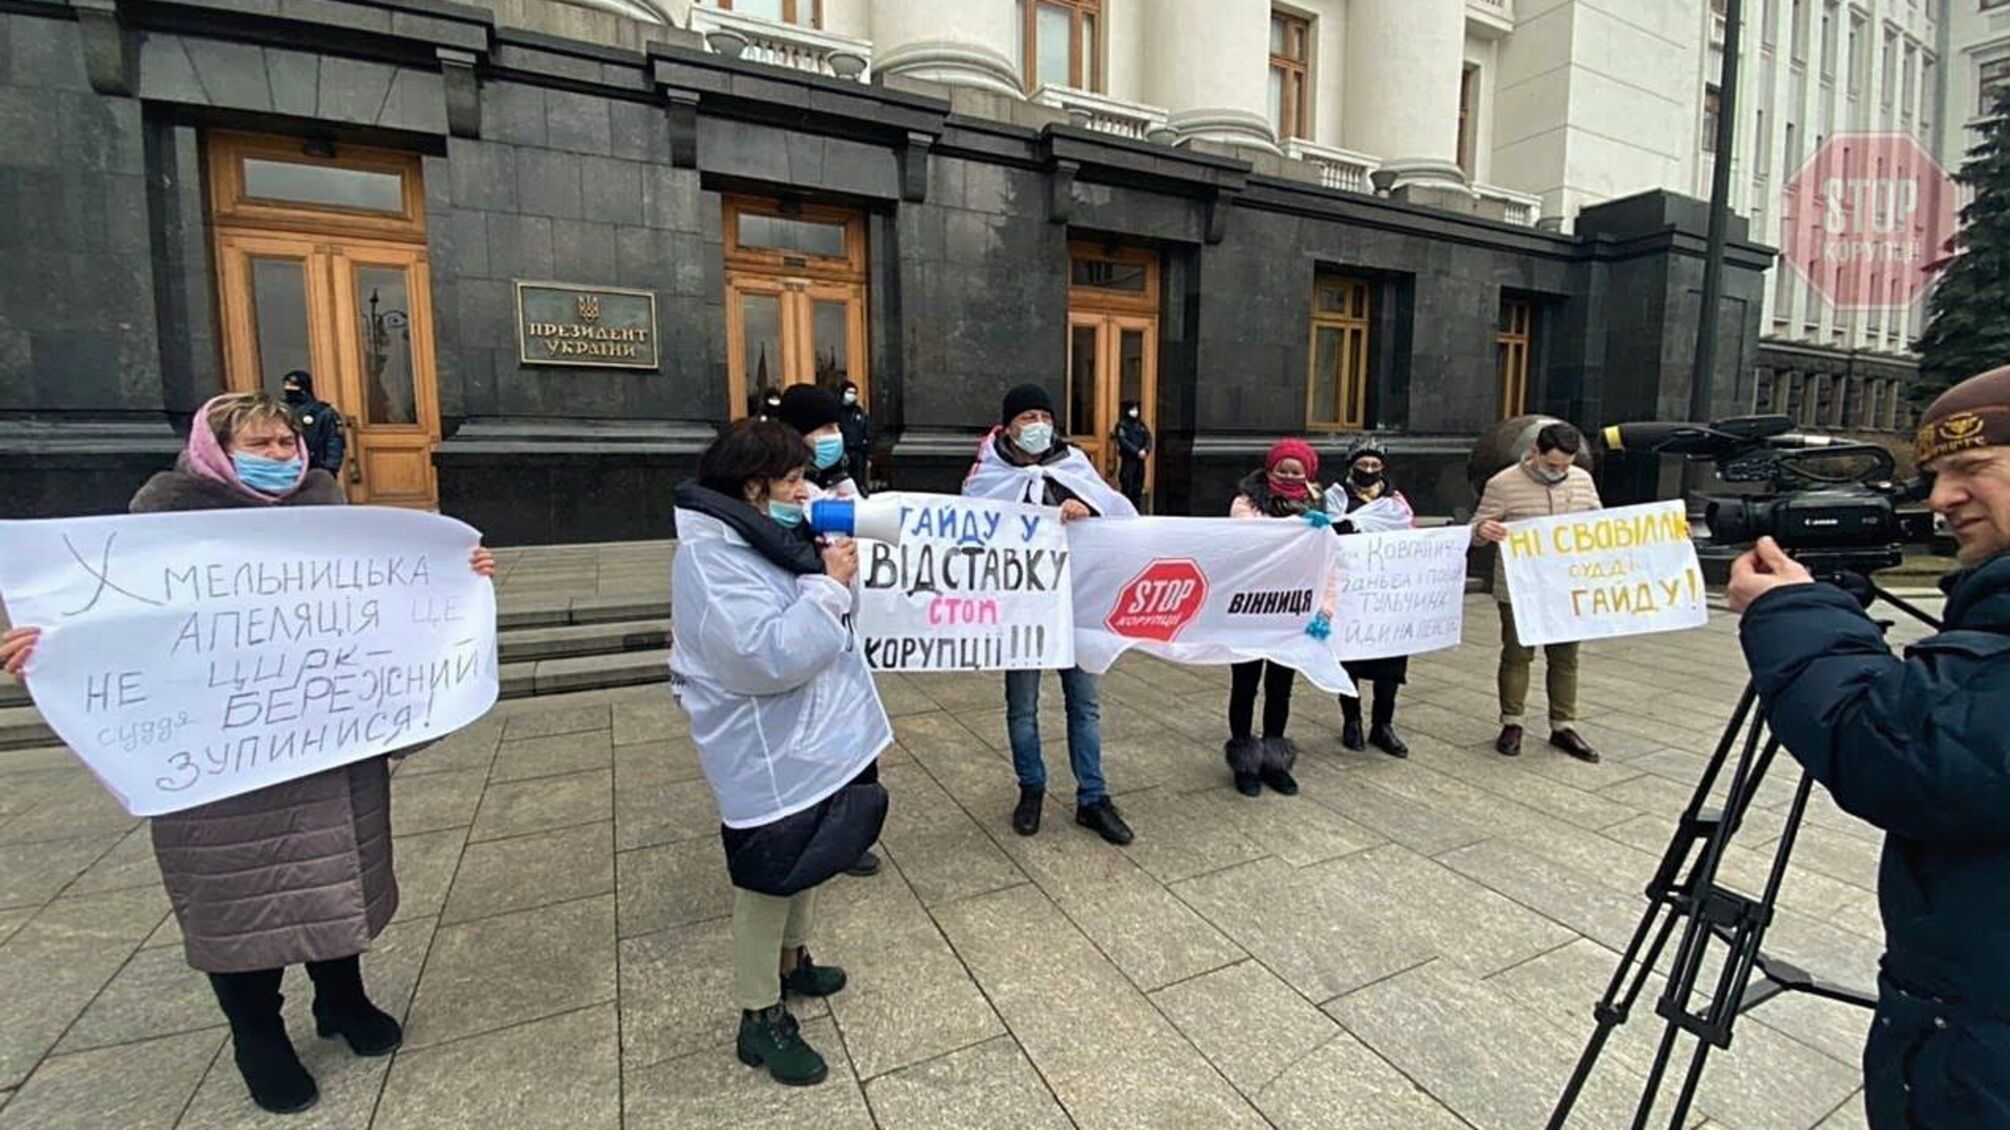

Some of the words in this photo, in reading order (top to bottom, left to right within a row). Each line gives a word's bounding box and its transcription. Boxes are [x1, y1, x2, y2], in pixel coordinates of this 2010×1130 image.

[529, 322, 648, 342] ПРЕЗИДЕНТ
[545, 339, 636, 358] УКРАЇНИ
[901, 505, 1001, 546] ГАЙДУ
[1510, 531, 1542, 557] НІ
[864, 543, 1067, 597] ВІДСТАВКУ
[1126, 579, 1196, 614] STOP
[1228, 589, 1314, 616] ВІННИЦЯ
[171, 596, 380, 656] АПЕЛЯЦІЯ
[87, 670, 147, 714] НЕ
